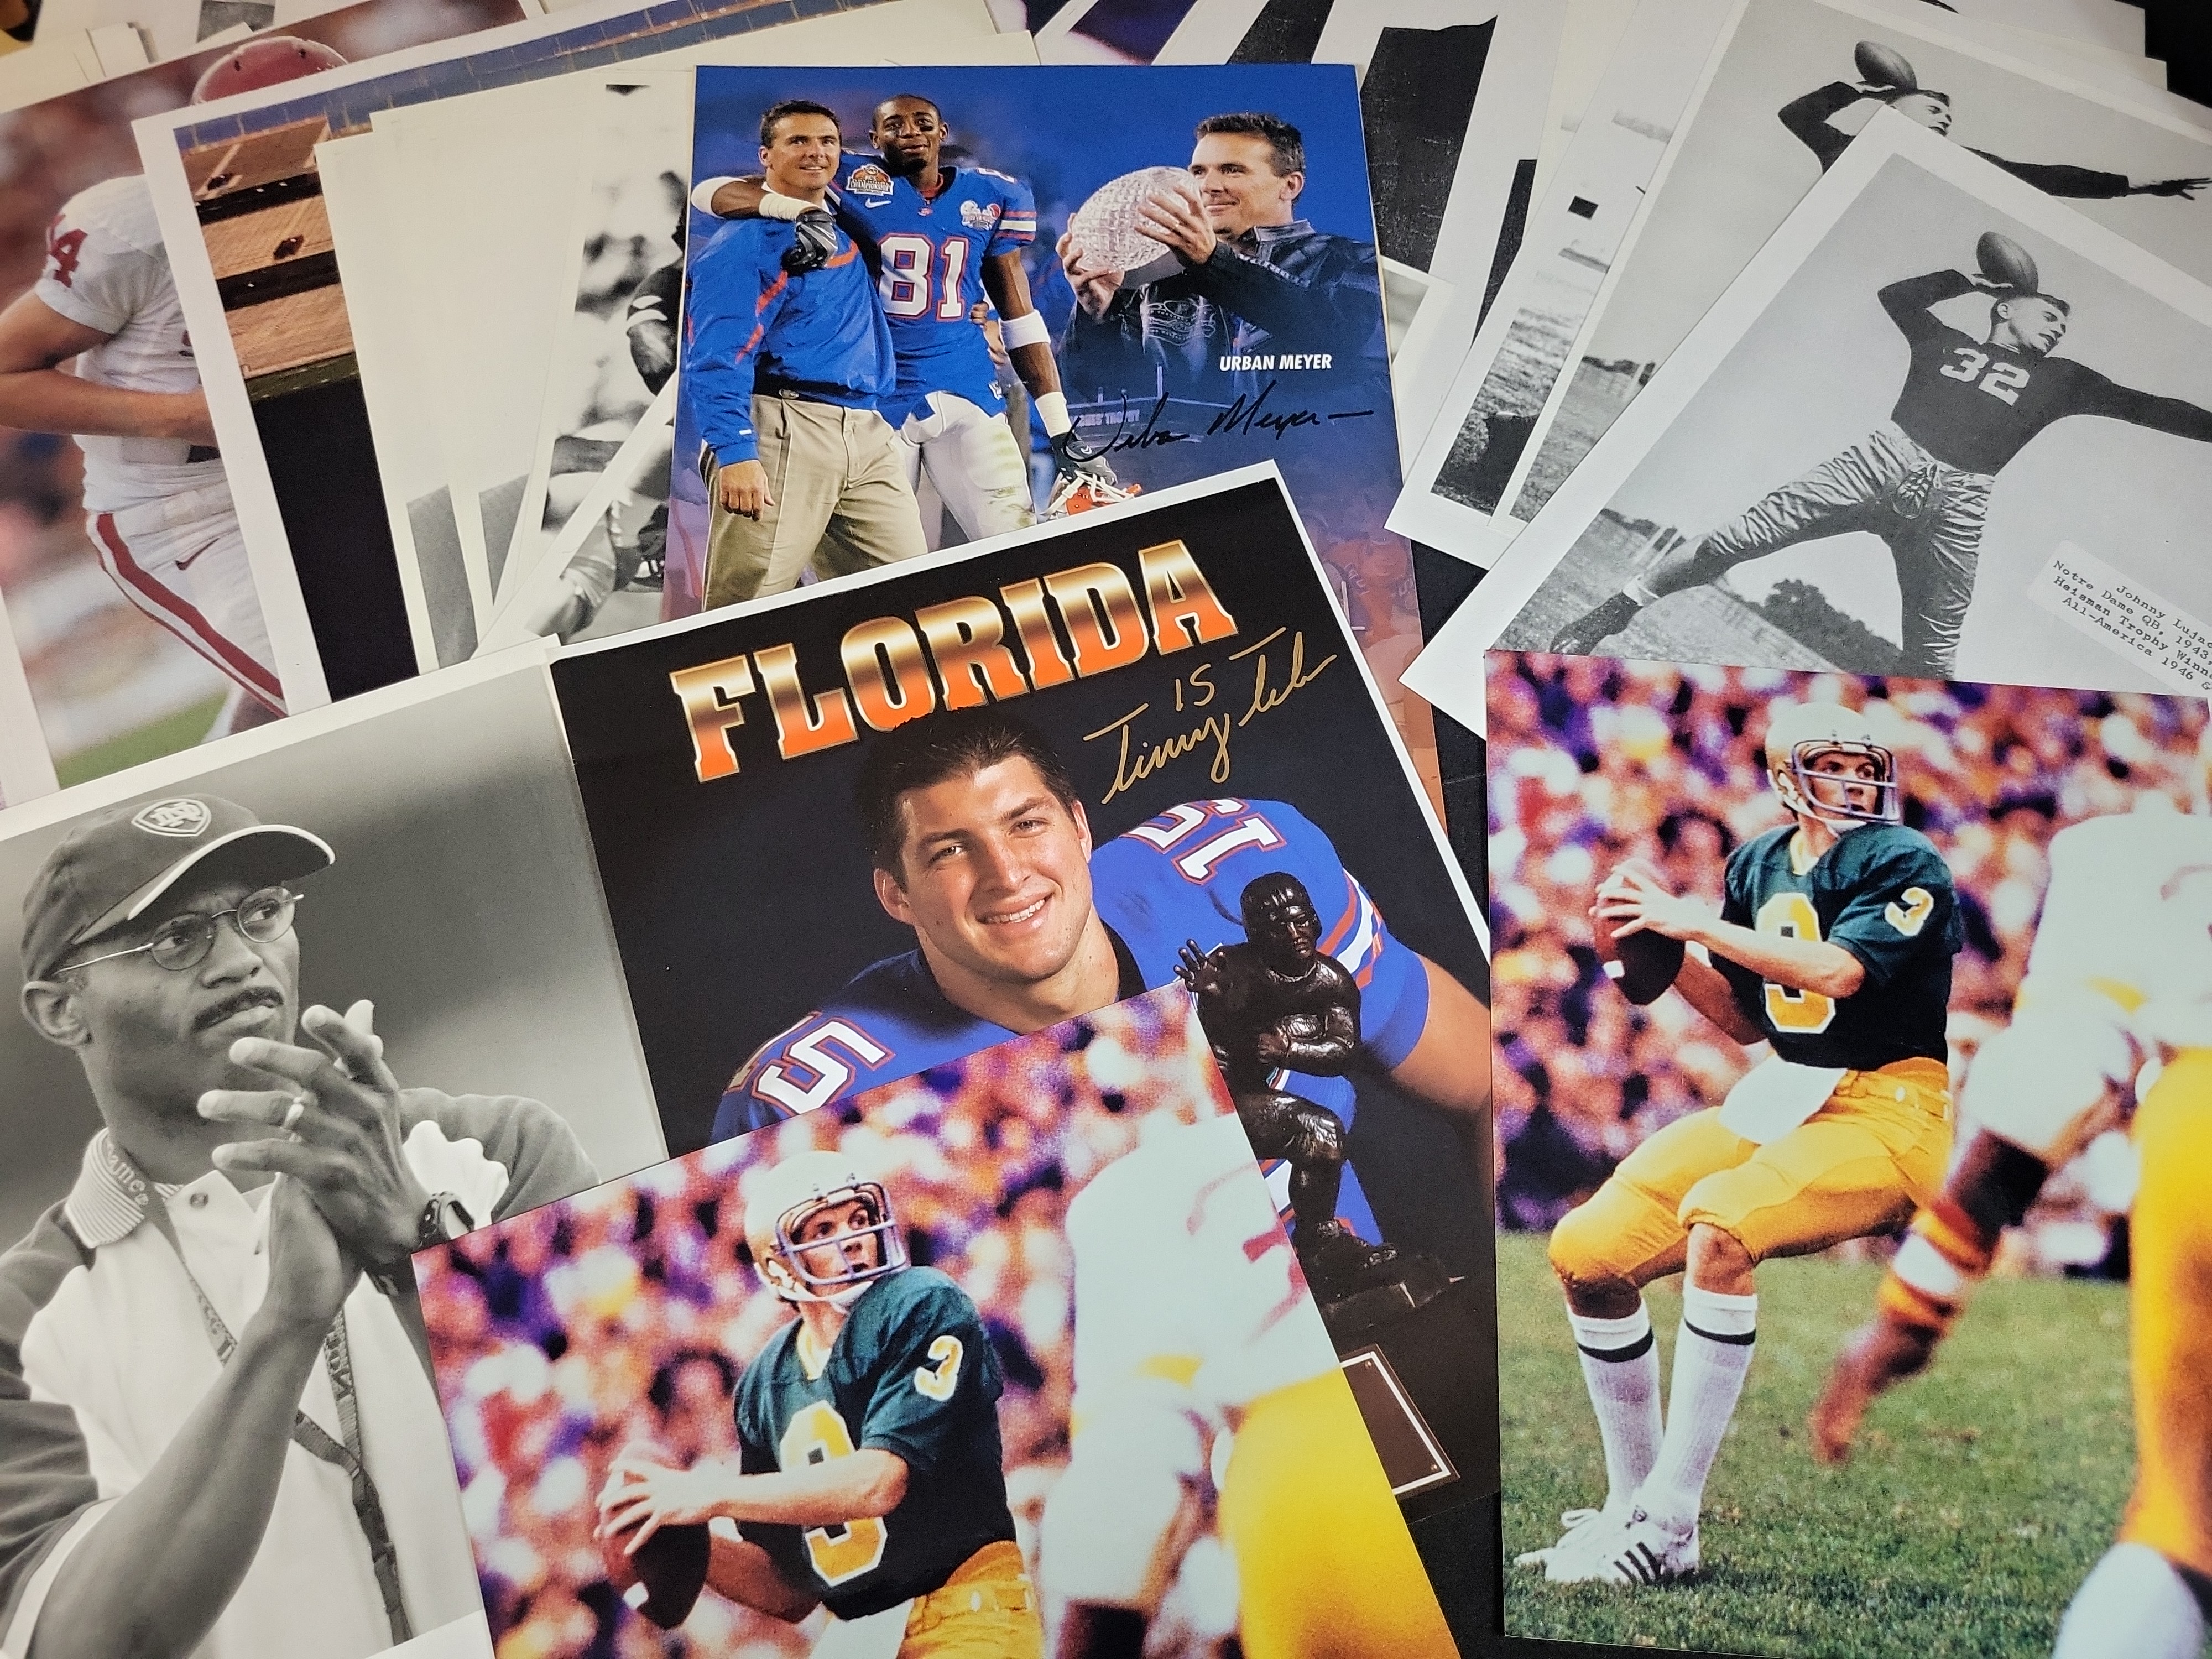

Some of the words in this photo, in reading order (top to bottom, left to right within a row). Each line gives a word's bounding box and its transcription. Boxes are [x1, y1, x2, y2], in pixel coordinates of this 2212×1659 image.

[878, 232, 970, 321] 81
[1219, 356, 1275, 372] URBAN
[1279, 354, 1333, 371] MEYER
[1939, 347, 2030, 406] 32
[2053, 560, 2094, 591] Notre
[2101, 589, 2134, 615] Dame
[2141, 614, 2164, 636] QB,
[2053, 576, 2111, 617] Heisman
[2119, 615, 2169, 651] Trophy
[2116, 585, 2166, 619] Johnny
[669, 538, 1240, 784] FLORIDA
[2062, 597, 2153, 657] All-America
[2161, 656, 2194, 680] 1946
[1884, 886, 1934, 937] 3
[914, 1335, 964, 1402] 3
